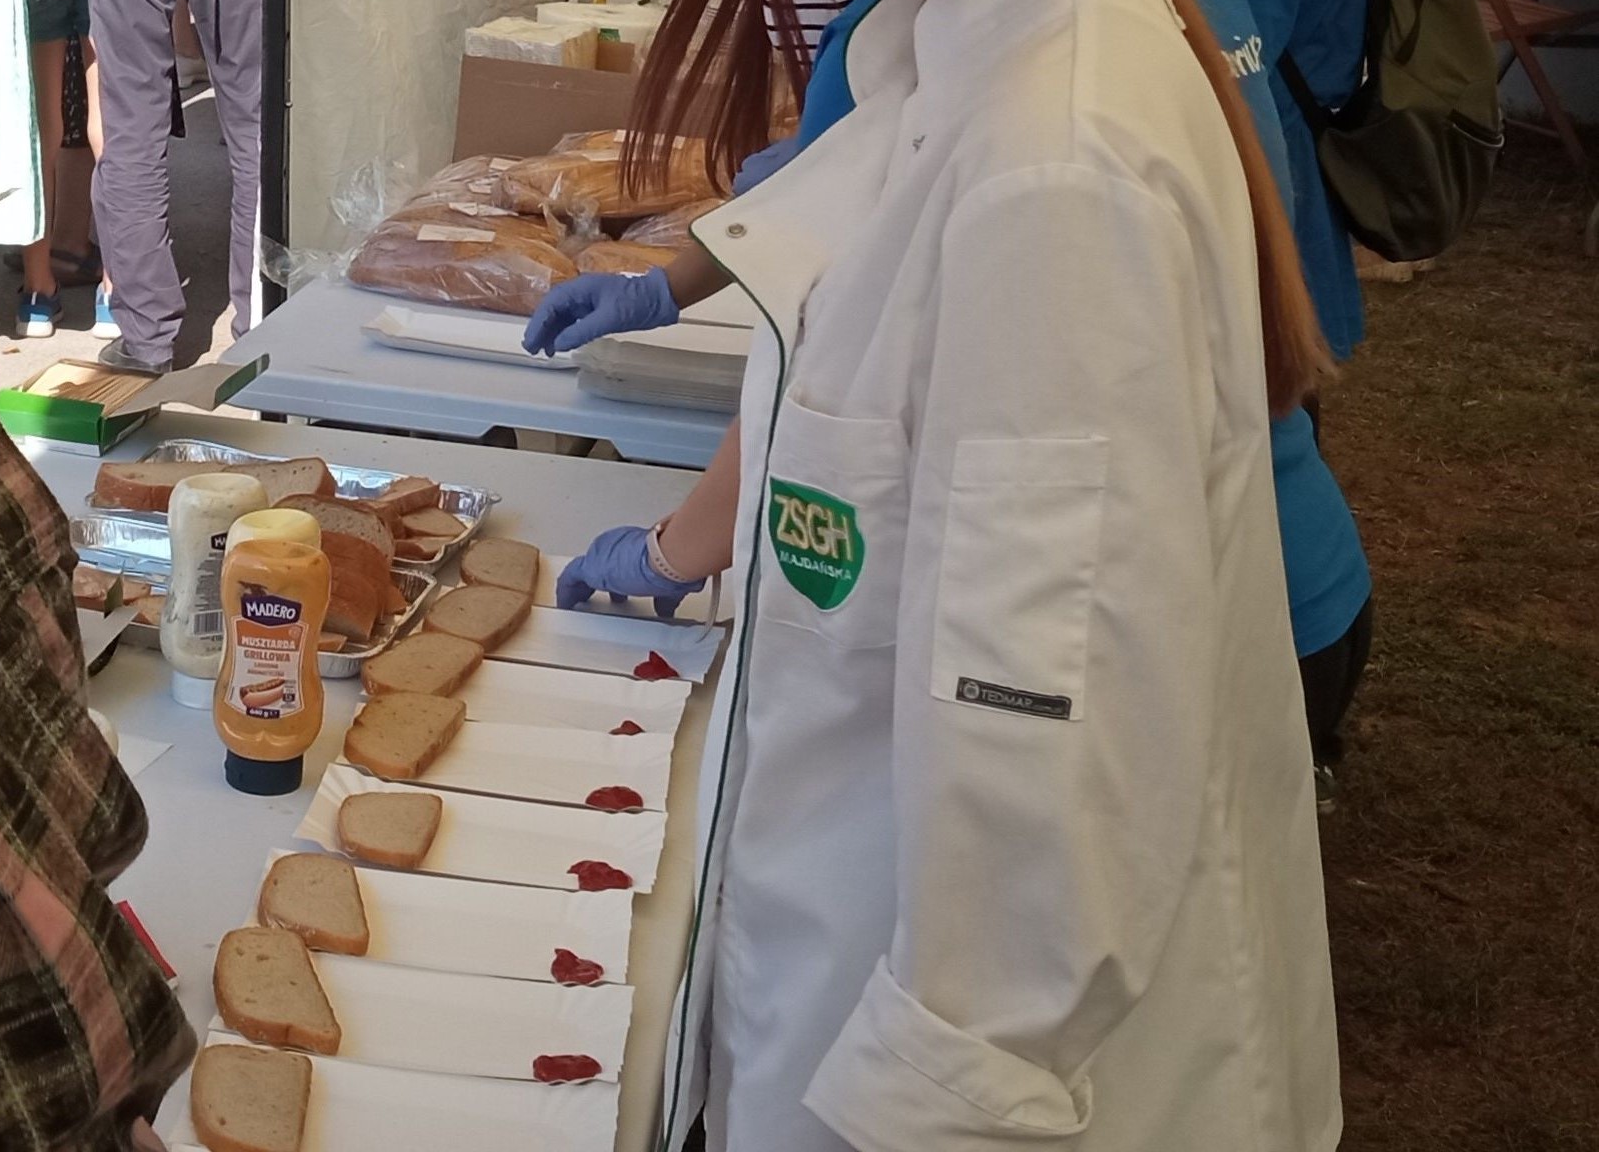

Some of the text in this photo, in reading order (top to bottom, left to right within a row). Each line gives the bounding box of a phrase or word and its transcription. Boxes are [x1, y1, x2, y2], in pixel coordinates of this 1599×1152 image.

[773, 493, 854, 562] ZSGH
[779, 549, 853, 581] MAJDAŃSKA
[245, 602, 297, 619] MADERO
[241, 635, 297, 649] MUSZTARDA
[244, 649, 291, 662] GRILLOWA
